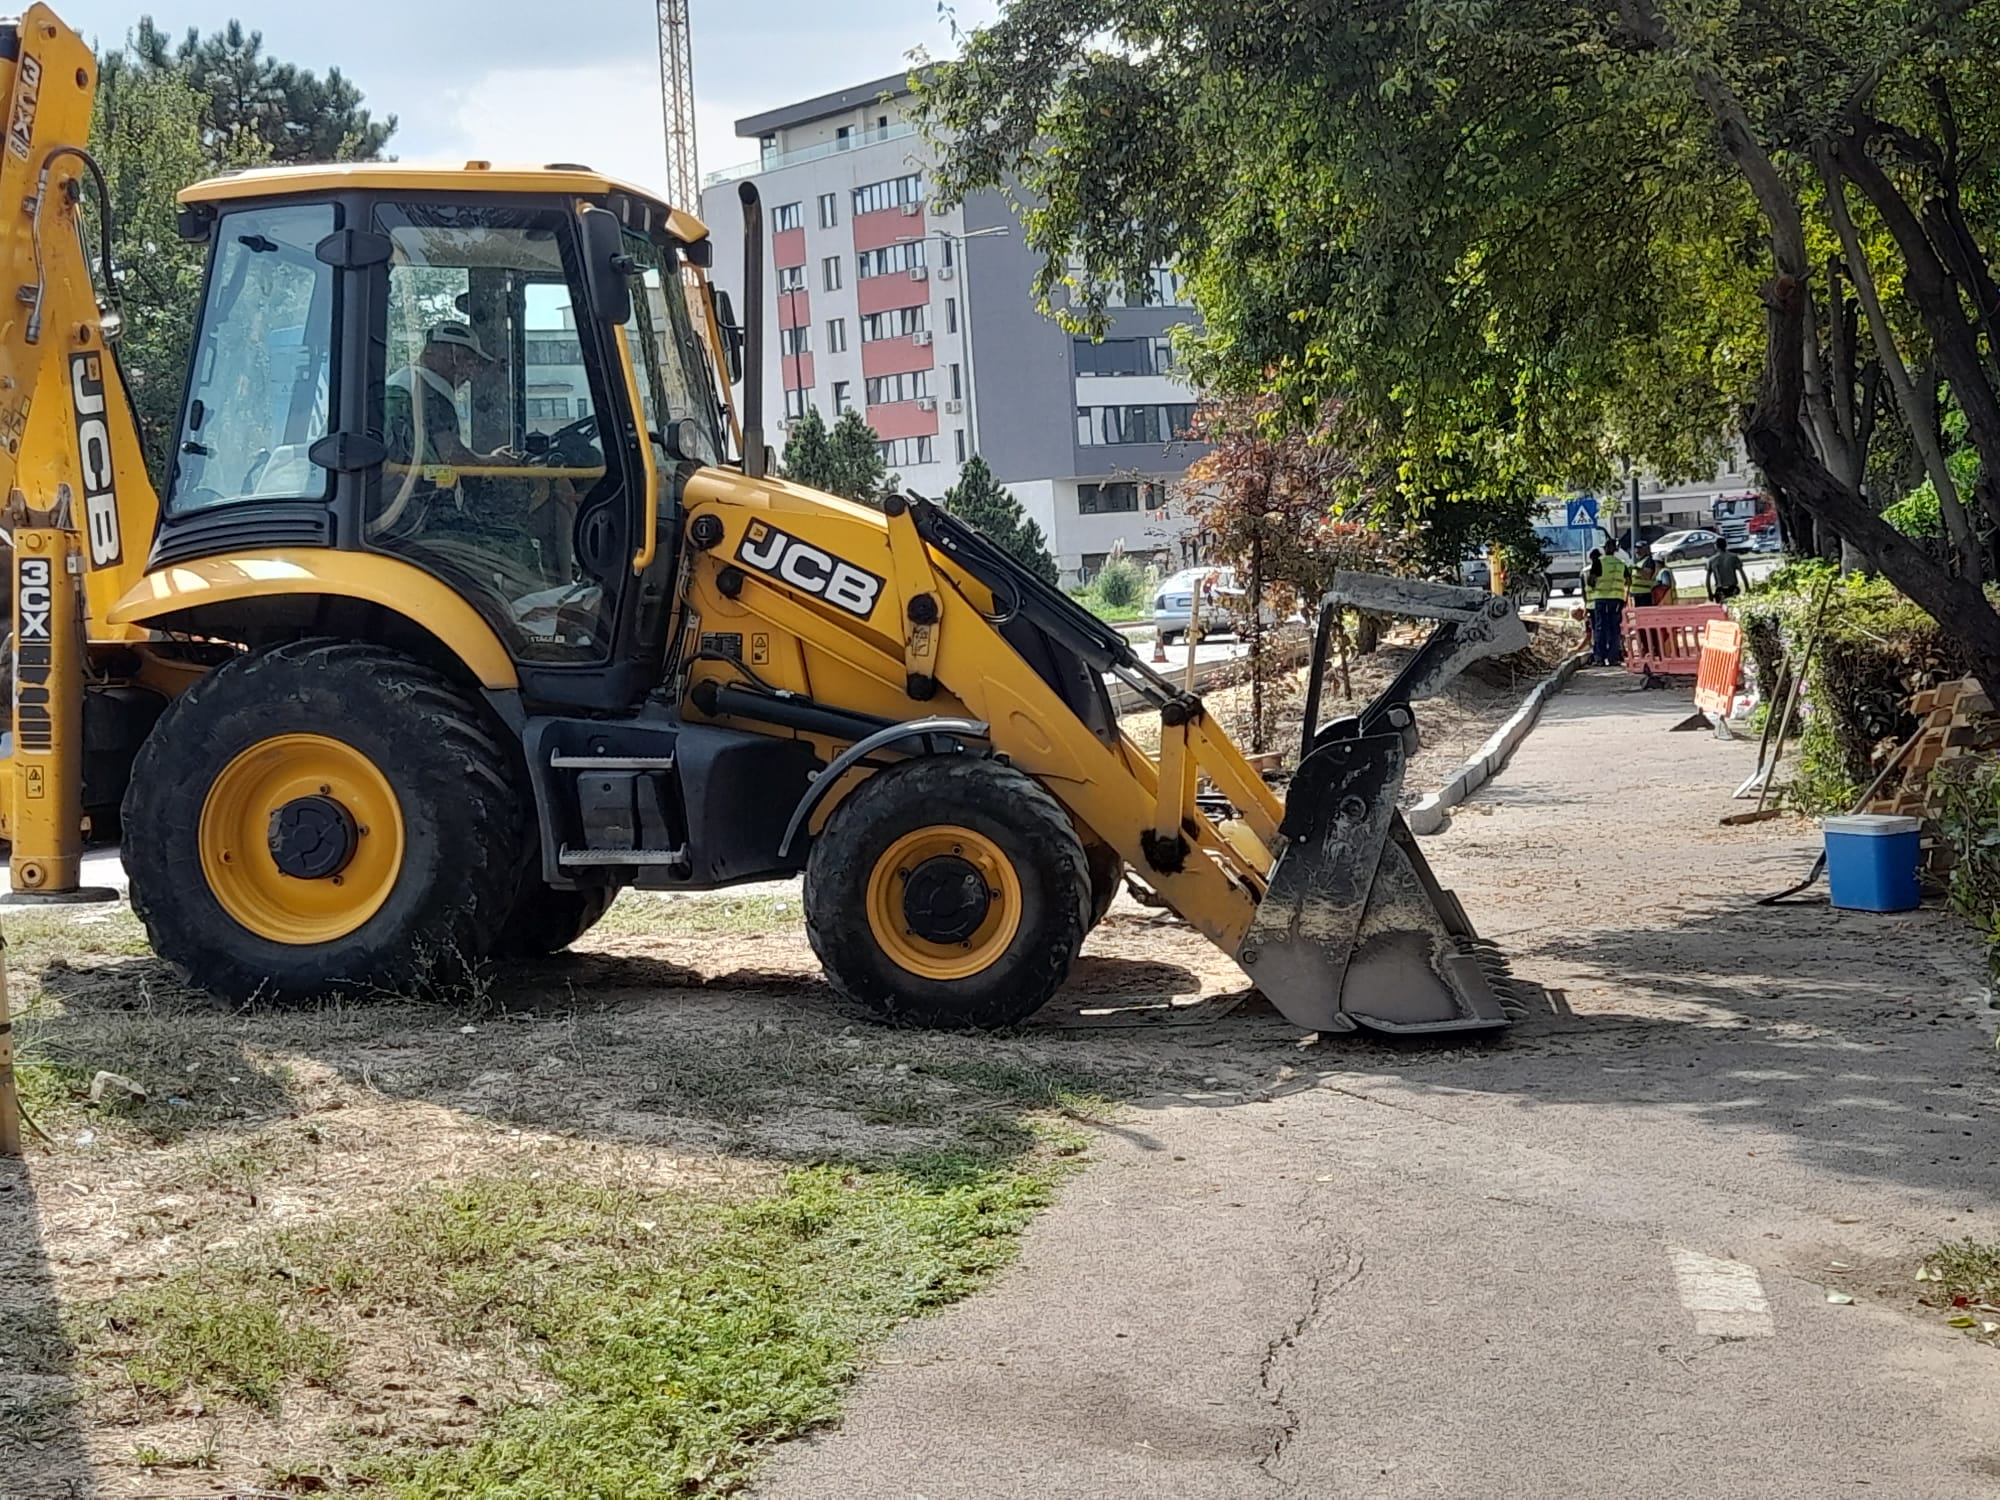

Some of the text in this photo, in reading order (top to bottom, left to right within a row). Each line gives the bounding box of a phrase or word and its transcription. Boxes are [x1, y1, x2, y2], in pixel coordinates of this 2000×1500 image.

[72, 358, 120, 566] JCB
[21, 560, 51, 637] 3CX
[741, 533, 879, 615] JCB
